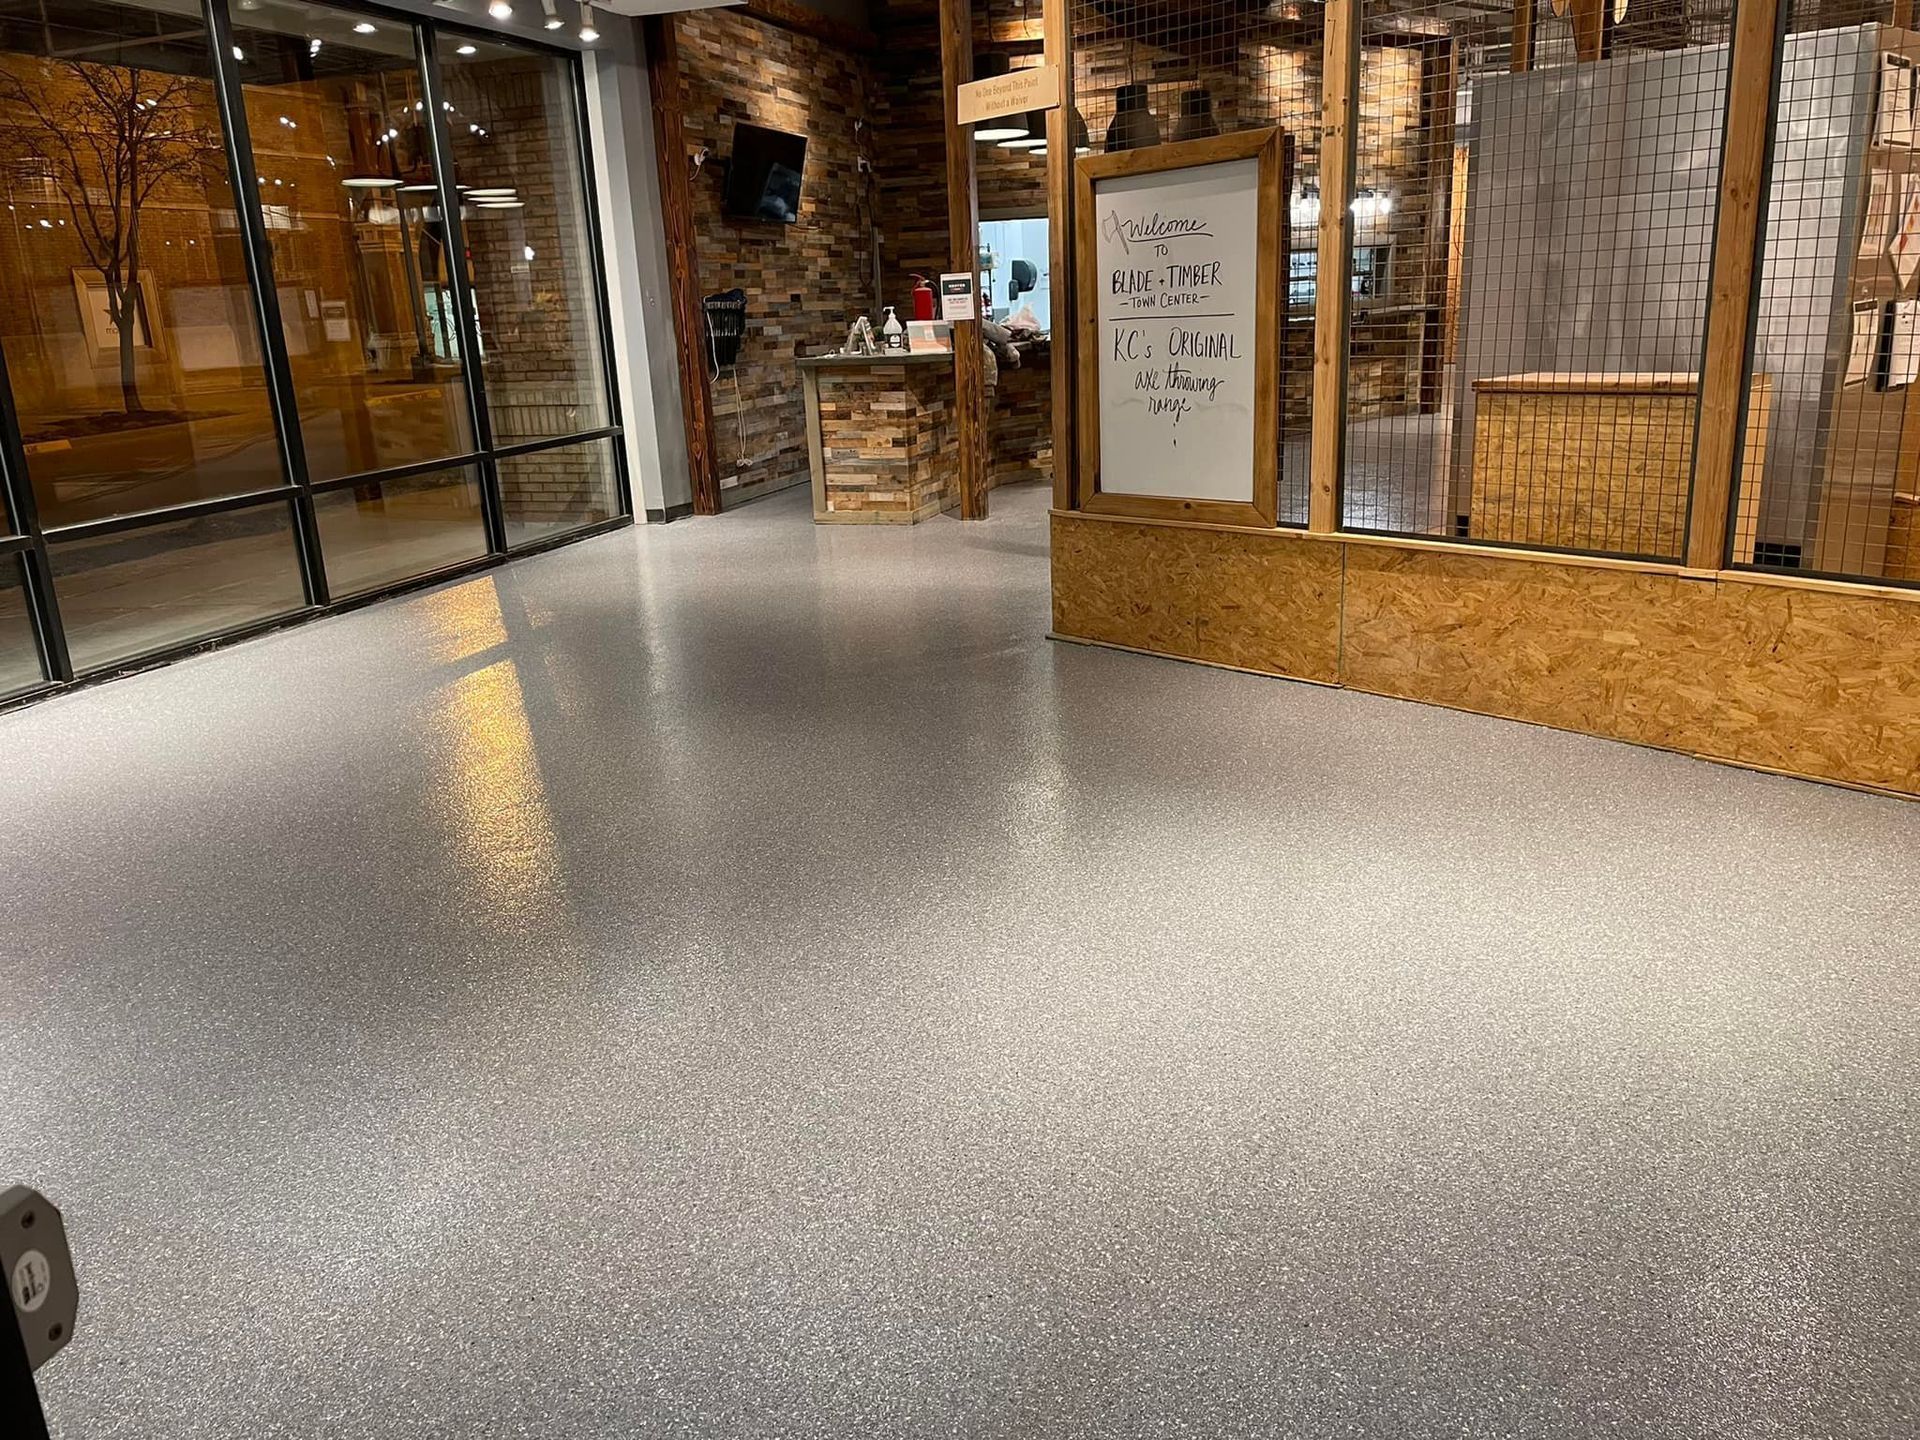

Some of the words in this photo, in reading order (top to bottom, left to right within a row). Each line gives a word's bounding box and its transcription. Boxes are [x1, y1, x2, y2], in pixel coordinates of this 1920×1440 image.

[1121, 212, 1207, 239] Welcome
[1154, 243, 1169, 258] TO
[1112, 269, 1154, 295] BLADE
[1166, 261, 1223, 289] TIMBER
[1114, 327, 1152, 361] KC's
[1168, 327, 1242, 361] ORIGINAL
[1135, 367, 1160, 391] axe
[1162, 362, 1225, 402] throwing
[1148, 395, 1192, 423] range
